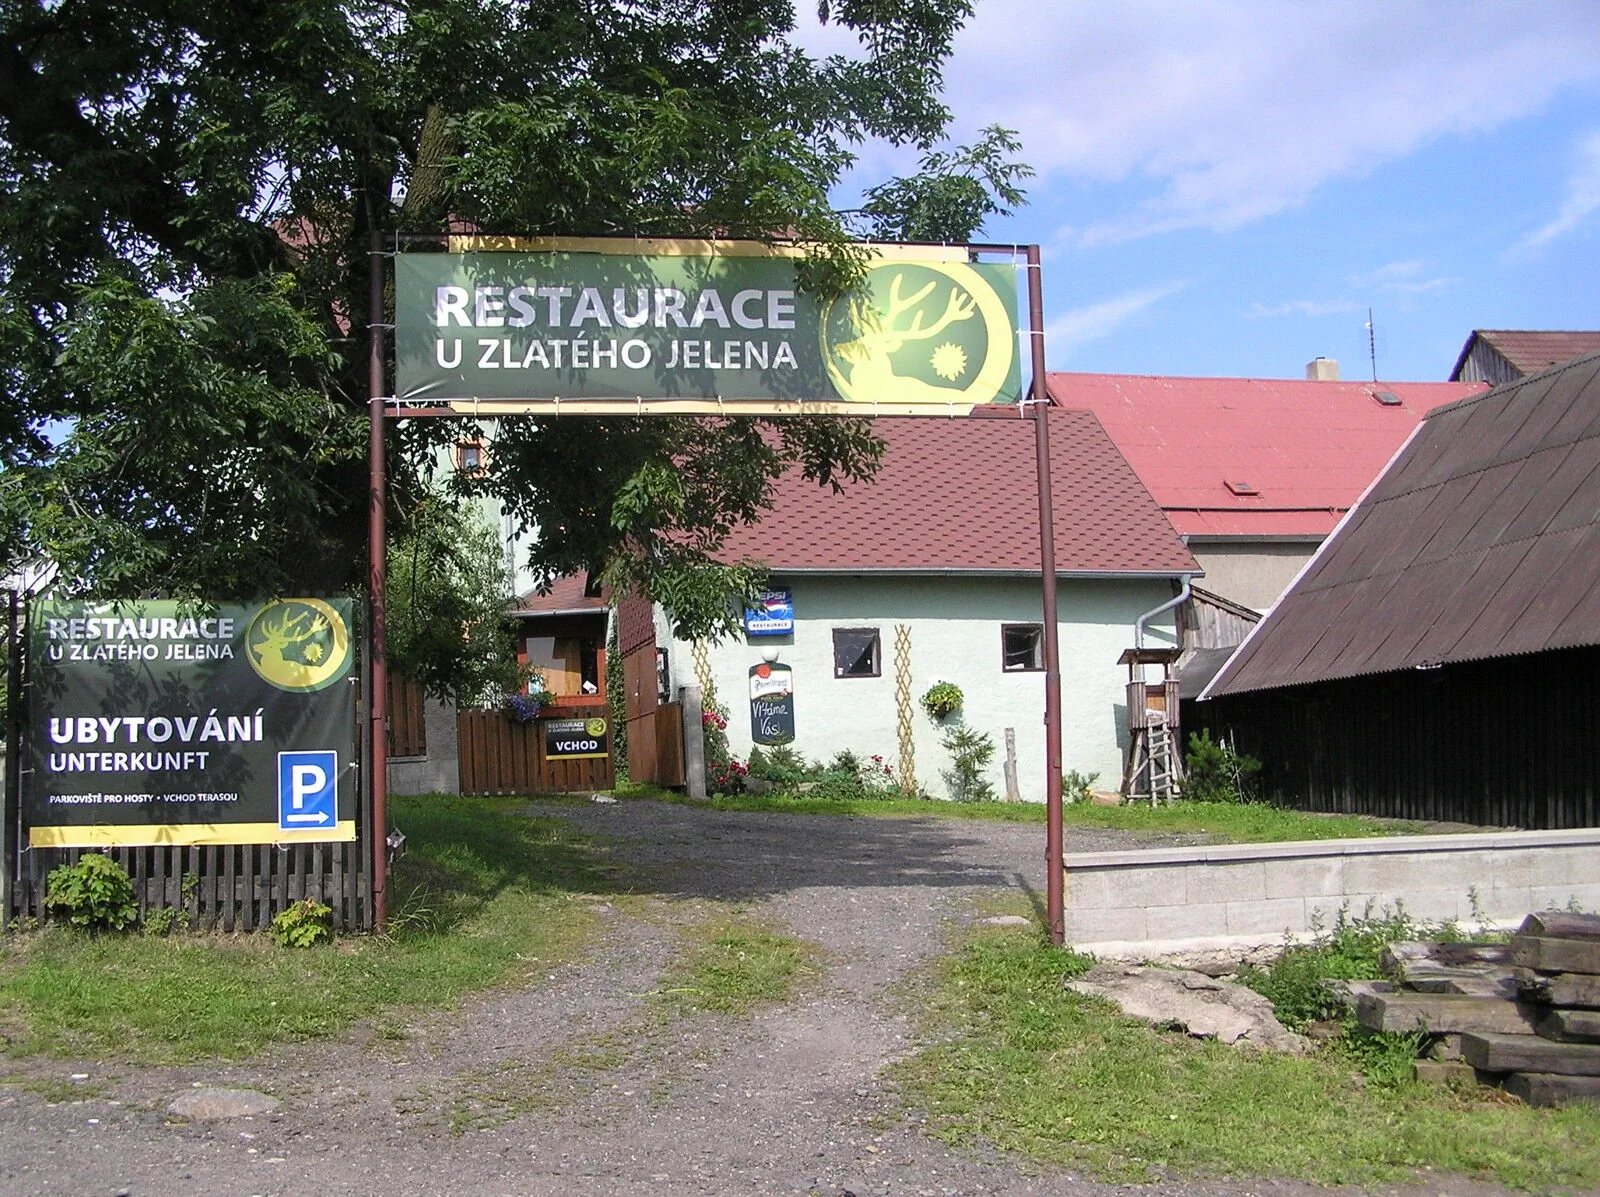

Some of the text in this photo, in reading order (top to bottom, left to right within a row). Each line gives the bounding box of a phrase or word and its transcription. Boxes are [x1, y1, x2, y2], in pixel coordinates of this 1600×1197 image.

[435, 285, 796, 330] RESTAURACE
[435, 331, 799, 371] U ZLATÉHO JELENA
[755, 591, 786, 600] EPSI
[49, 617, 234, 640] RESTAURACE
[49, 640, 234, 661] U ZLATÉHO JELENA
[49, 707, 265, 744] UBYTOVÁNÍ
[556, 740, 598, 751] VCHOD
[49, 751, 209, 772] UNTERKUNFT
[291, 764, 326, 809] P
[49, 792, 238, 804] PARKOVIŠTĚ PRO HOSTY VCHOD TERASOU
